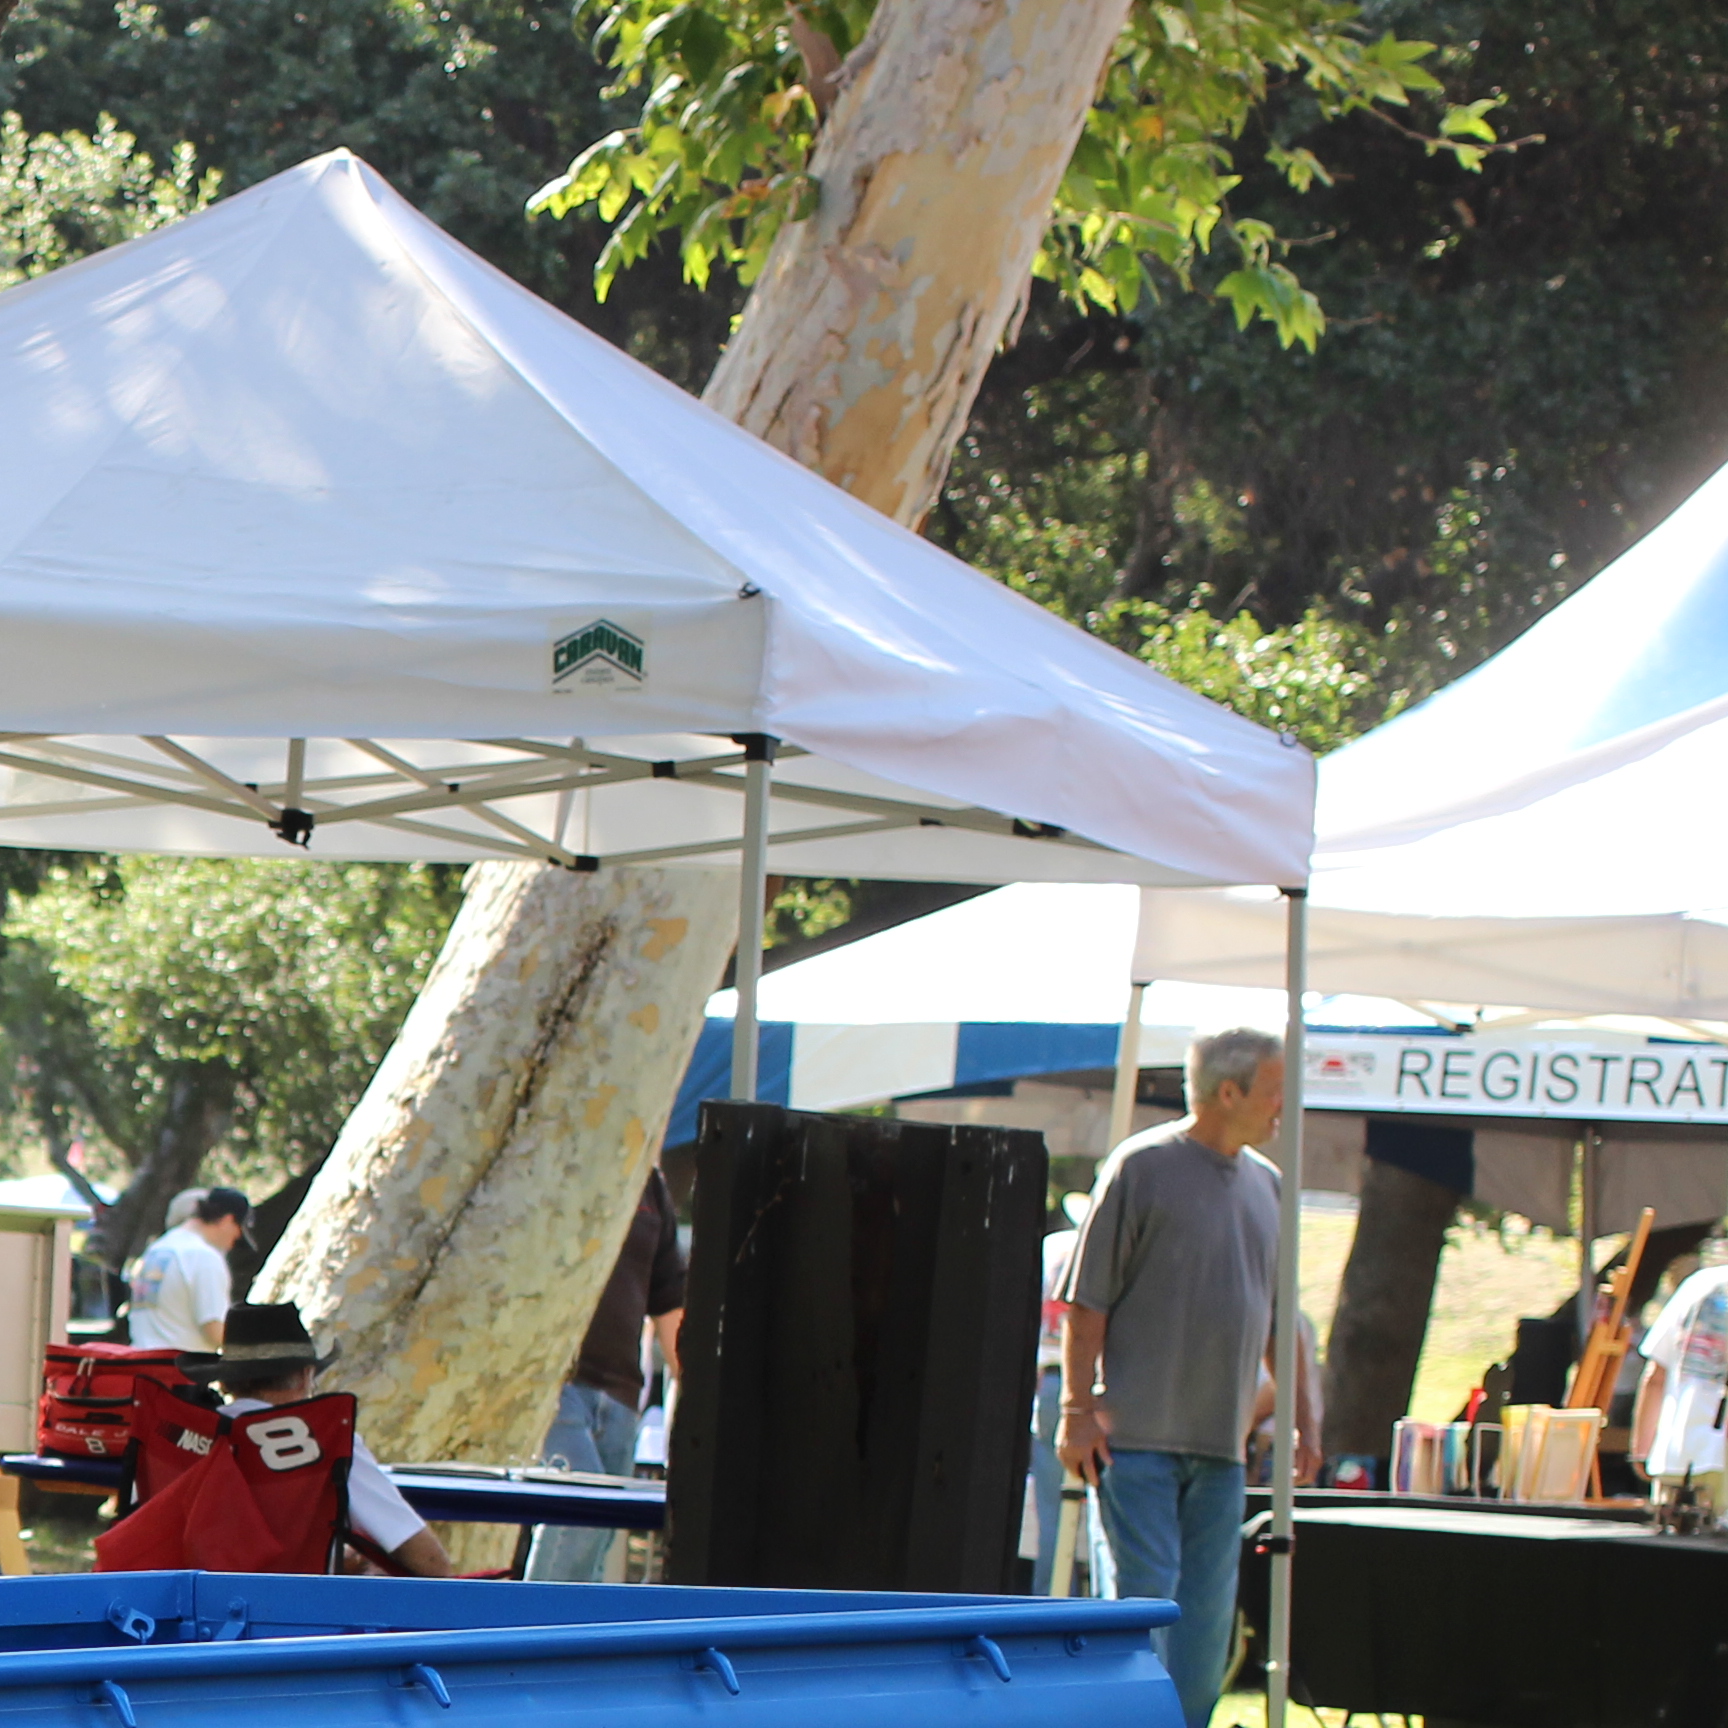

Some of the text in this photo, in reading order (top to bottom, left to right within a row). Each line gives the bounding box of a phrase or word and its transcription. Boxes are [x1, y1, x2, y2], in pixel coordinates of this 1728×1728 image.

[1395, 1048, 1728, 1108] REGISTRAT
[84, 1436, 107, 1454] 8
[246, 1416, 321, 1472] 8
